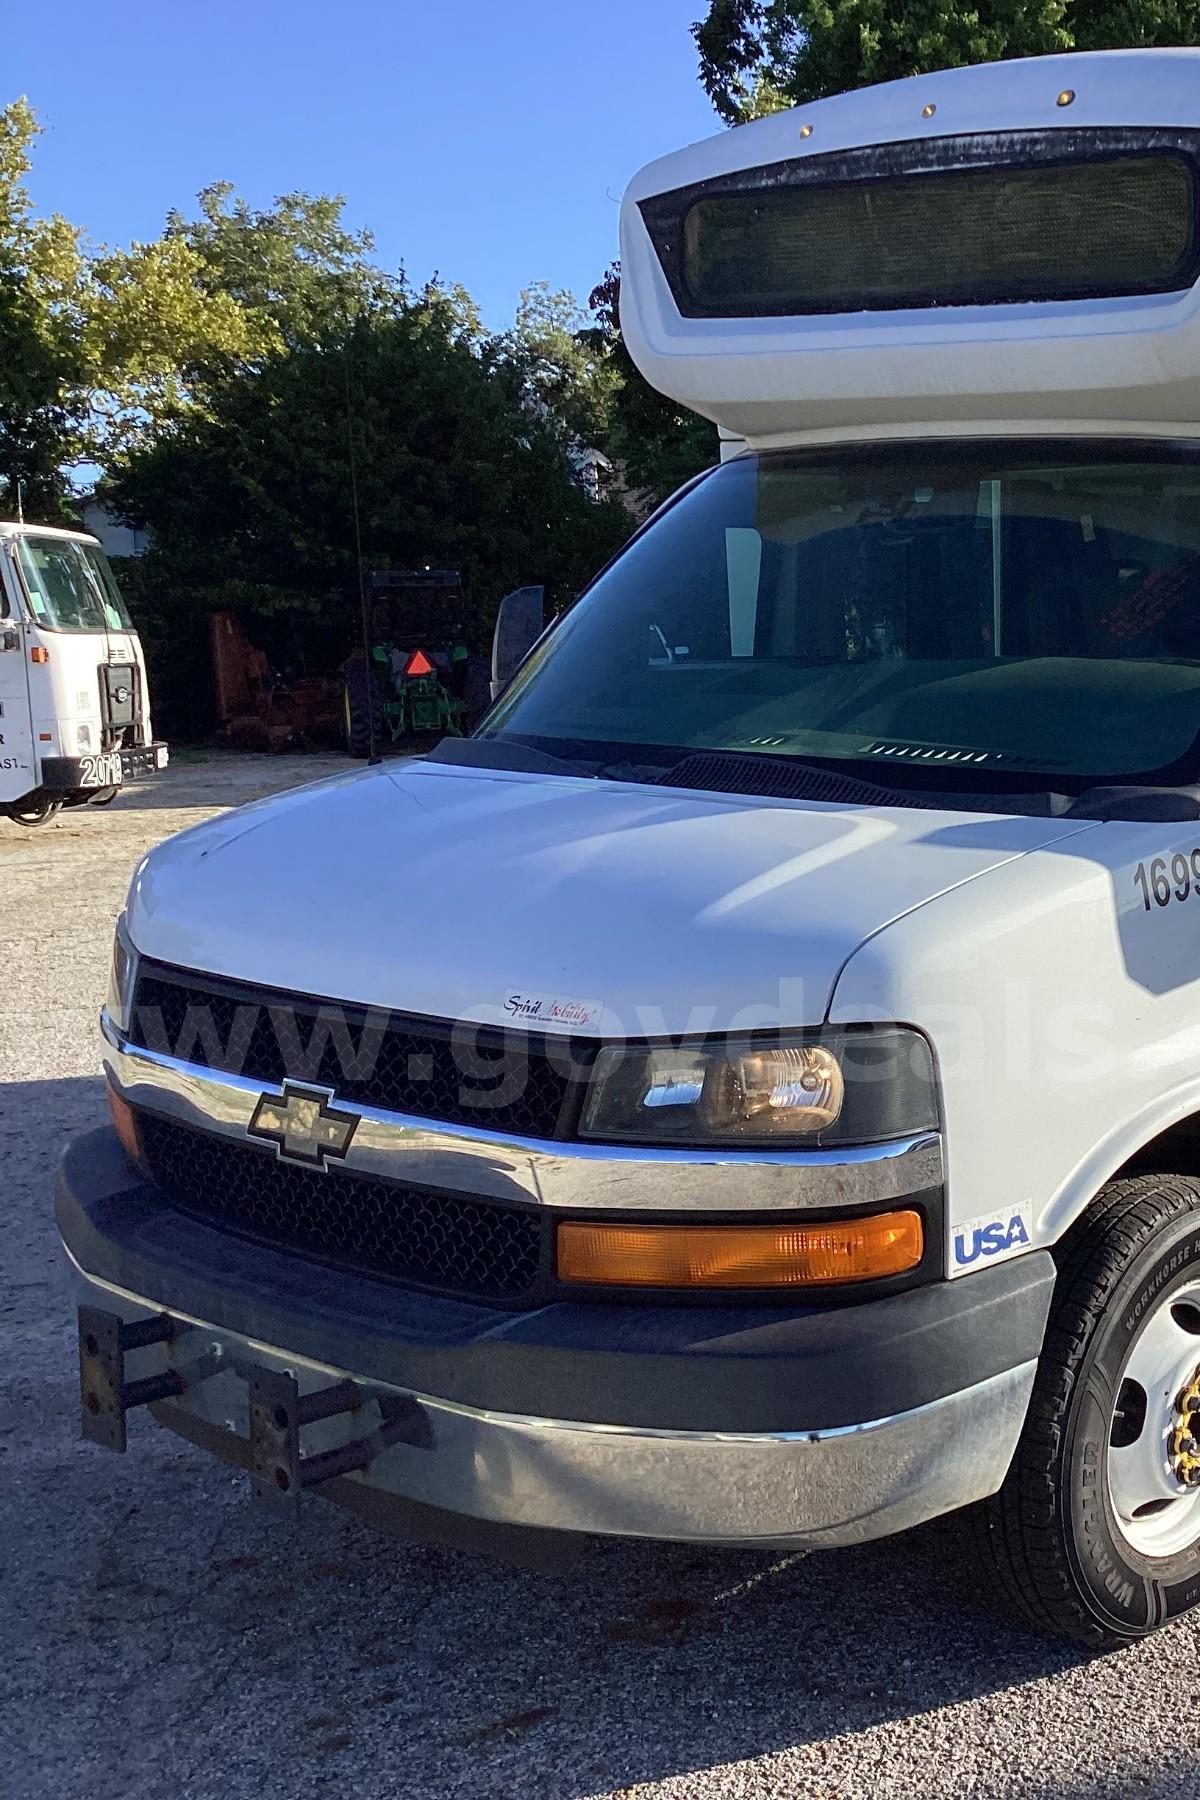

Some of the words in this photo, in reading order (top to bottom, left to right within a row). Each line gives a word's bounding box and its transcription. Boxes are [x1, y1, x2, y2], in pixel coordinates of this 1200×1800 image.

[503, 995, 543, 1017] Spirit
[954, 1214, 1030, 1265] USA
[1125, 1246, 1191, 1331] WORKHORSE
[1081, 1440, 1135, 1609] WRANGLER
